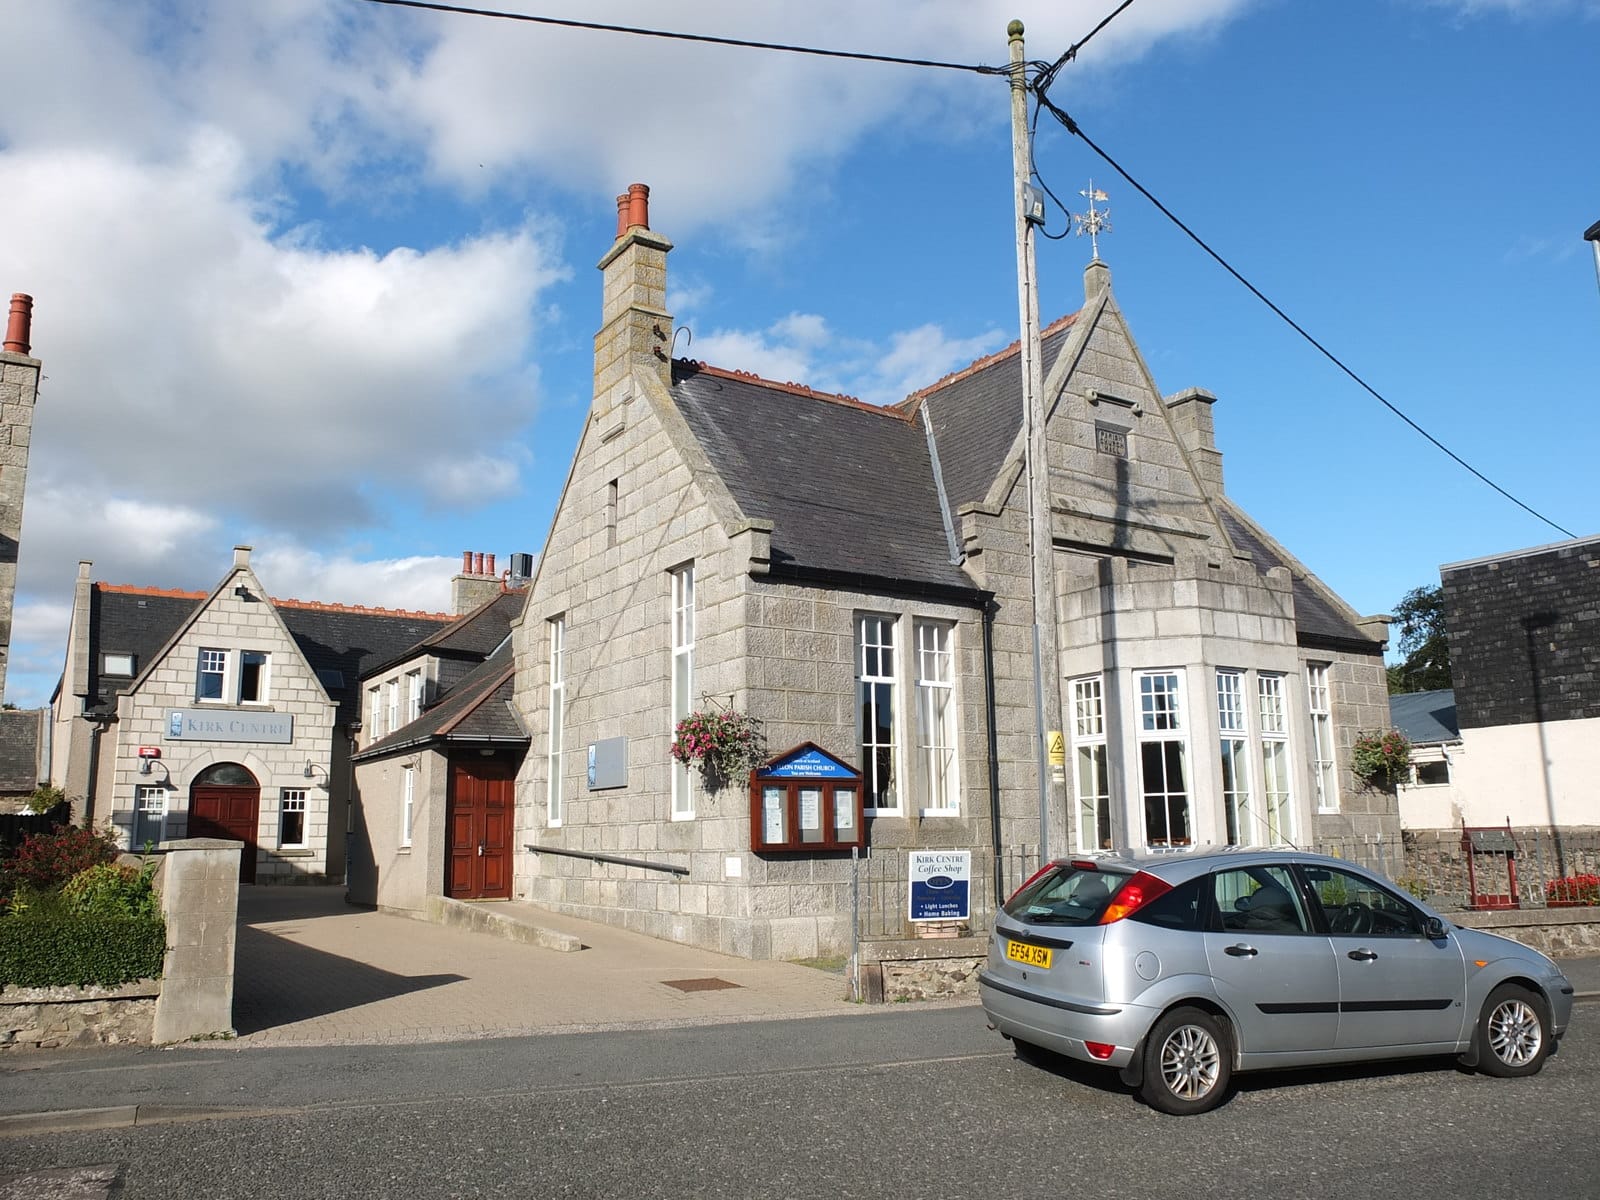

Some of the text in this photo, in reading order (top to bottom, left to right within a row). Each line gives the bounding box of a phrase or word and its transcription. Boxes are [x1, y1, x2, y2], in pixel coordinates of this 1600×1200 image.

[188, 719, 288, 735] KIRK CENTRE
[916, 855, 963, 863] KIRK CENTRE
[918, 864, 962, 874] Coffee Shop
[1010, 943, 1048, 966] EF54 XSM
